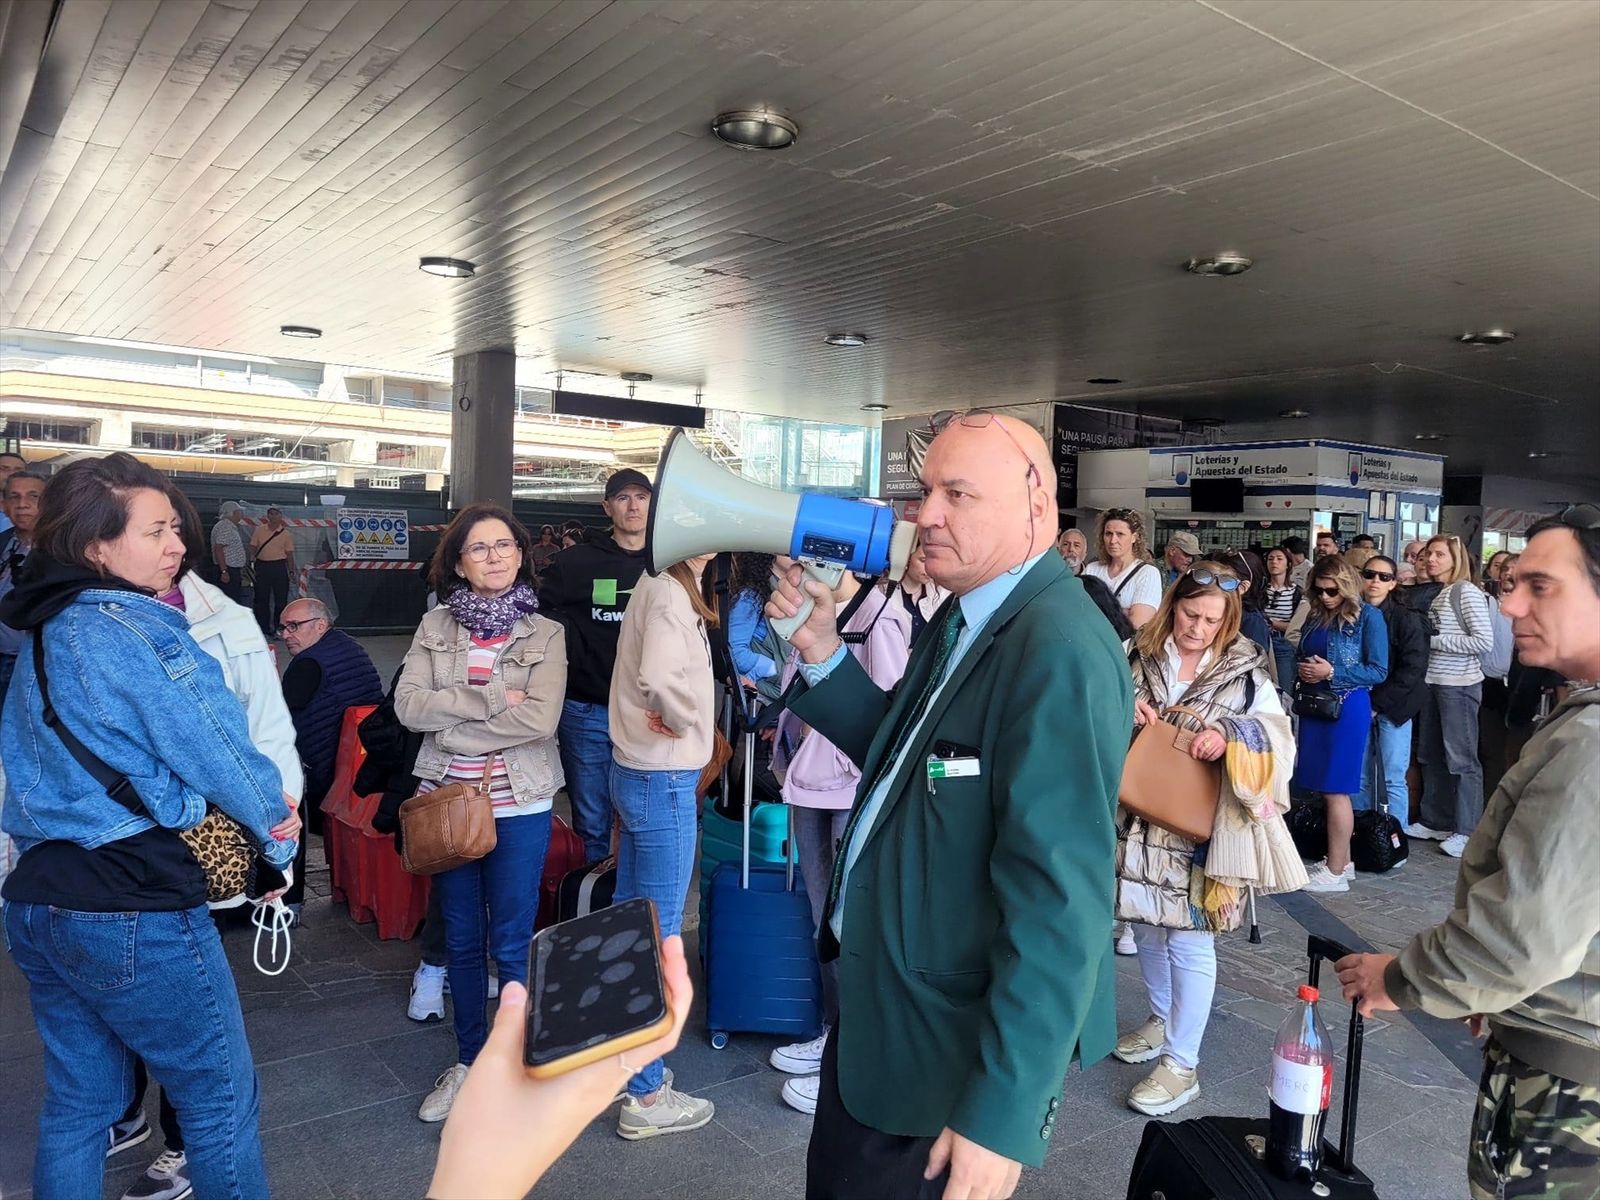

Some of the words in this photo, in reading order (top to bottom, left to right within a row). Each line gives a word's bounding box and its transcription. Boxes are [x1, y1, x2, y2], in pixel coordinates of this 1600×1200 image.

[1061, 430, 1079, 442] UNA
[1080, 432, 1107, 445] PAUSA
[1107, 436, 1129, 447] PARA
[887, 451, 903, 461] UNA
[1195, 455, 1231, 465] Loterías
[1233, 456, 1239, 466] y
[1363, 456, 1387, 467] Loterías
[1387, 460, 1392, 470] y
[1195, 466, 1237, 477] Apuestas
[1238, 465, 1252, 475] del
[1254, 464, 1288, 475] Estado
[1363, 468, 1390, 480] Apuestas
[1390, 471, 1399, 481] del
[1399, 472, 1418, 482] Estado
[592, 607, 626, 622] Kaw
